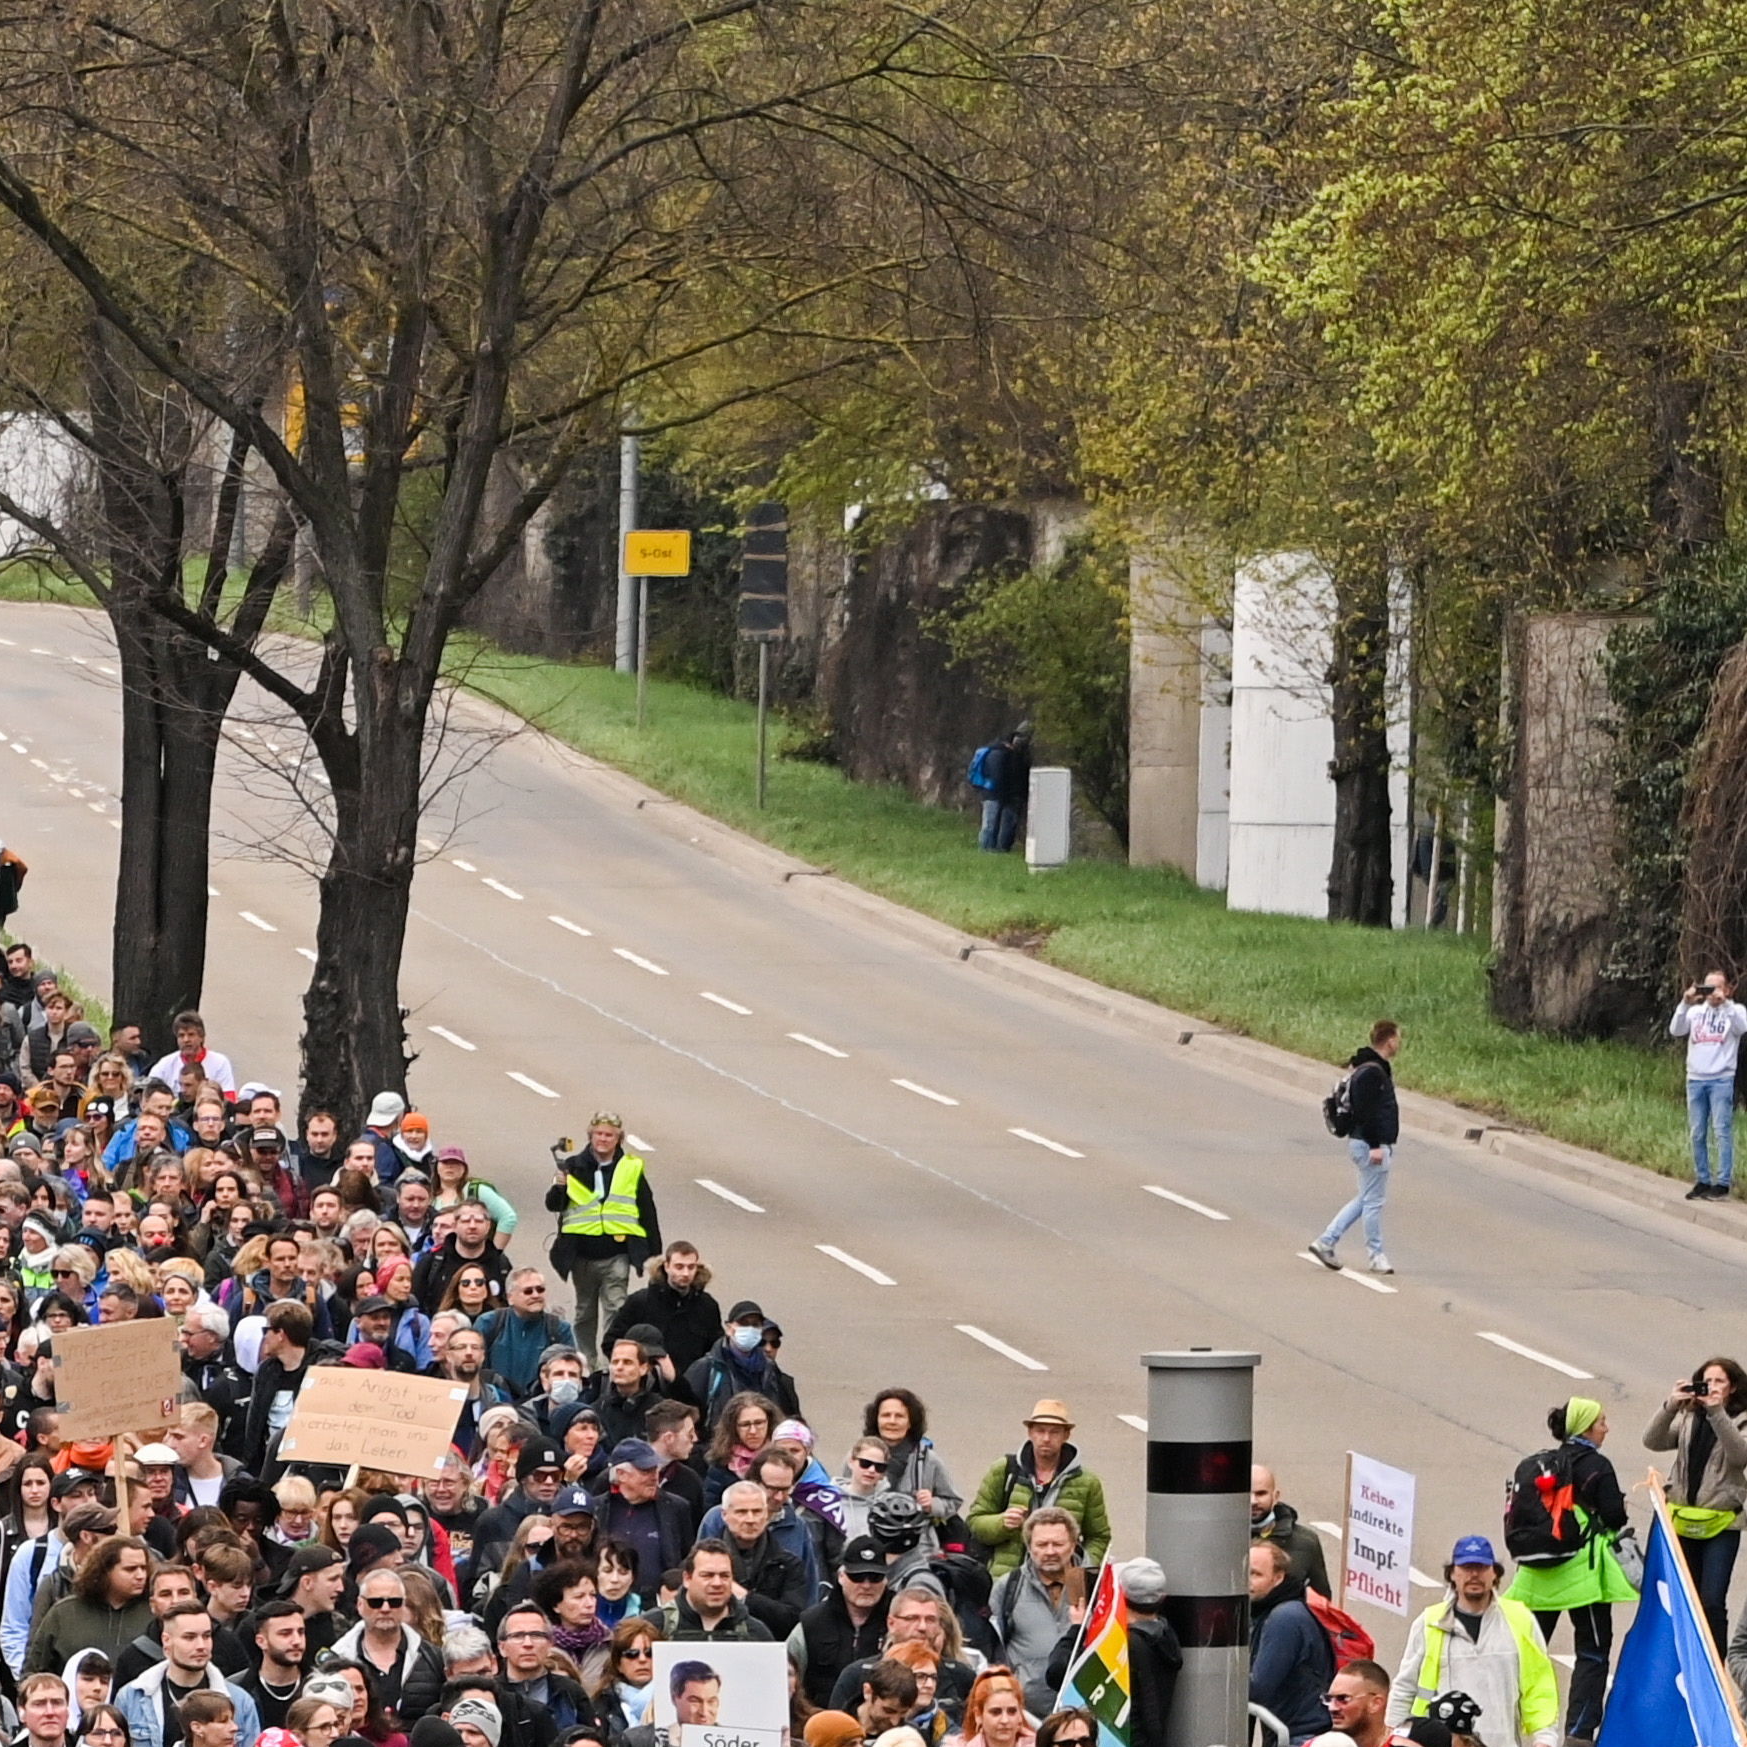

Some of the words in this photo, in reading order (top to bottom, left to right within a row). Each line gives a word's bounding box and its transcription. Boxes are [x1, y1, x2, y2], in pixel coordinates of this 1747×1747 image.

[361, 1378, 408, 1401] Angst
[390, 1403, 417, 1420] Tod
[326, 1438, 356, 1452] das
[361, 1440, 408, 1459] Leben
[1360, 1484, 1395, 1510] Keine
[1348, 1504, 1405, 1538] indirekte
[1353, 1537, 1399, 1571] Impf-
[1346, 1569, 1403, 1608] Pflicht
